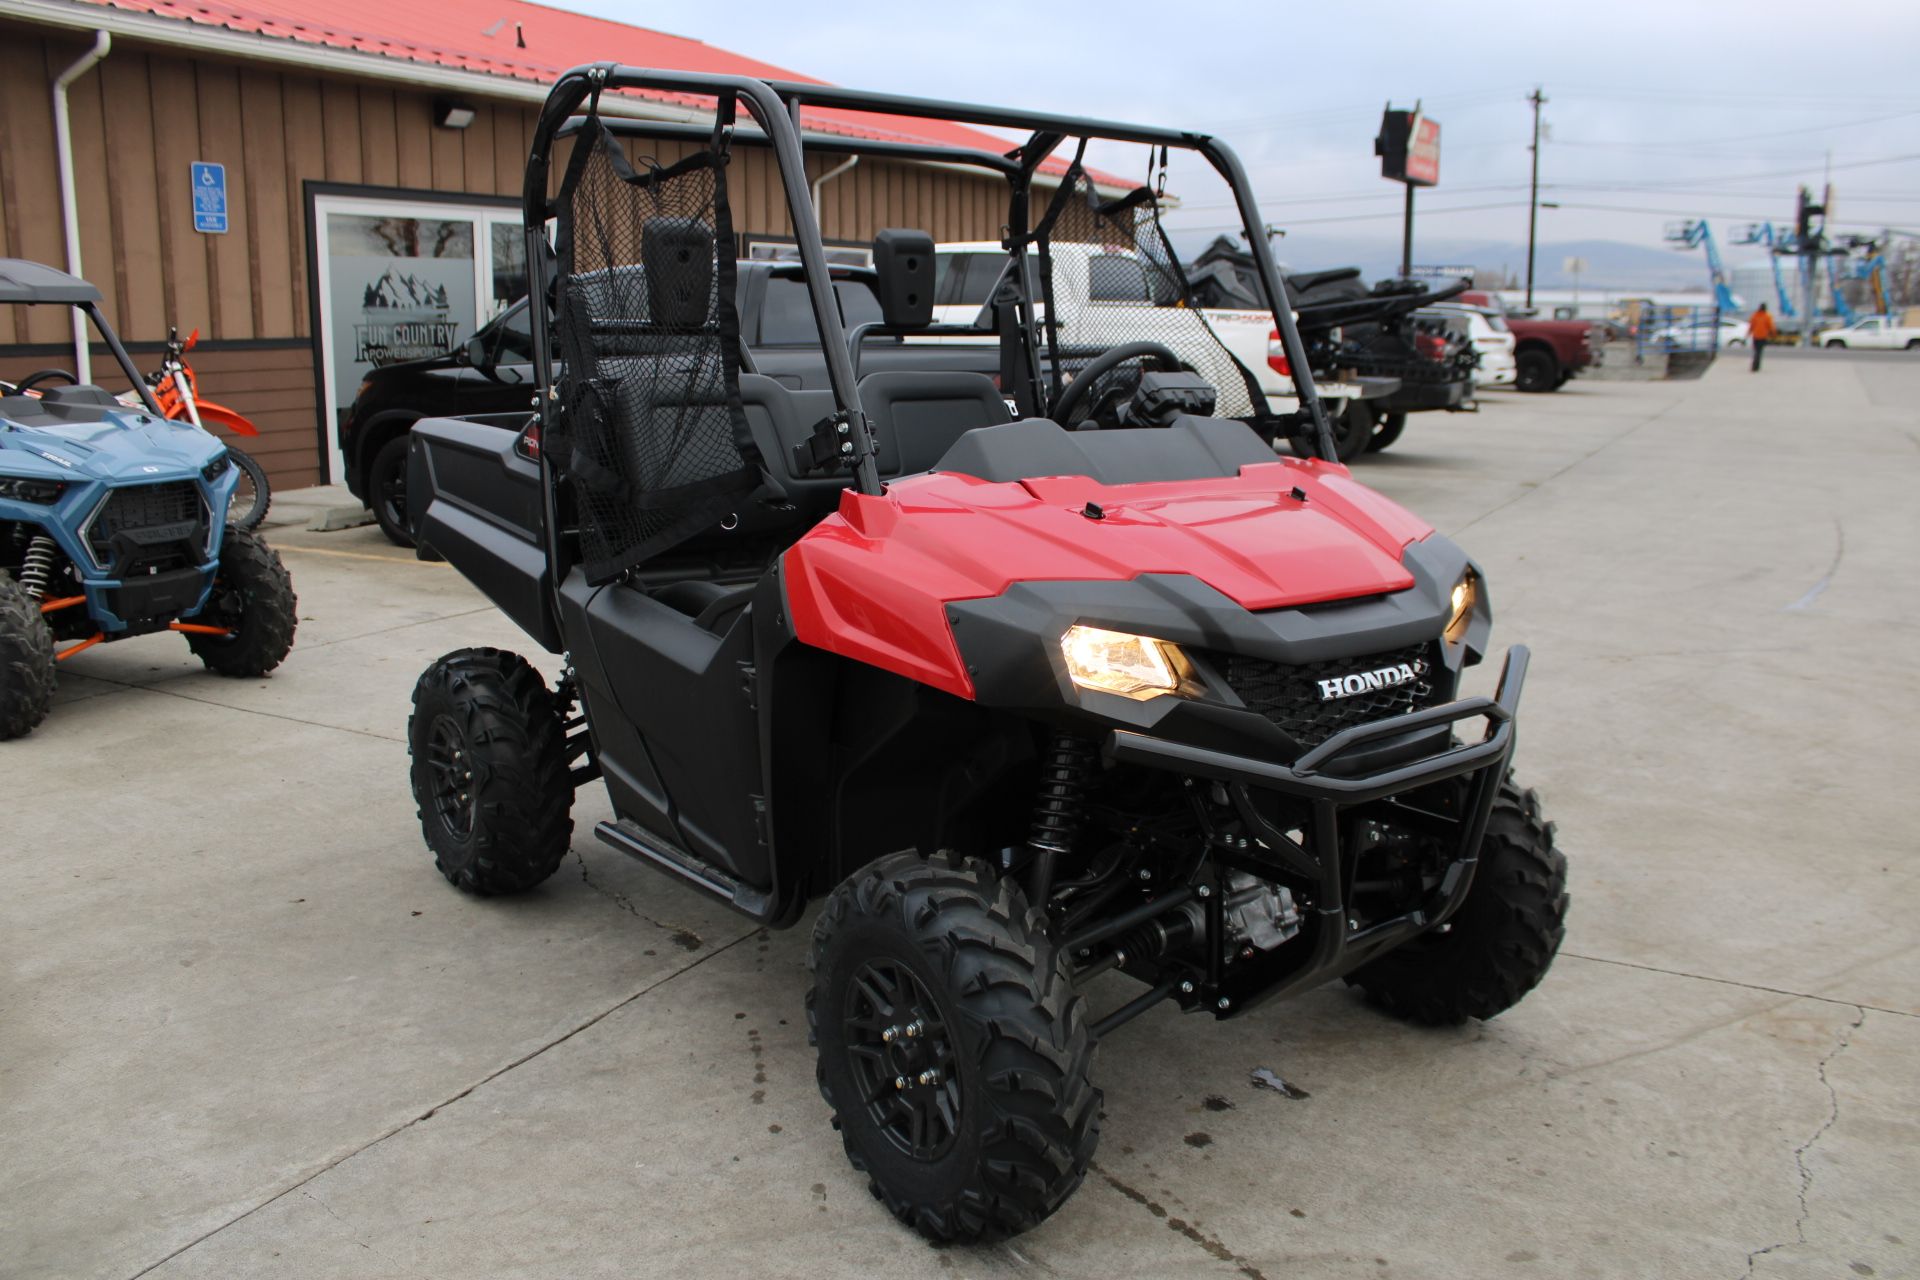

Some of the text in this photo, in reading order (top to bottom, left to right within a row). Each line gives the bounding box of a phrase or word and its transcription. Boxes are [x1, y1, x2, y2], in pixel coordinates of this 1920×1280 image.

[353, 322, 459, 362] FUN COUNTRY
[368, 346, 446, 360] POWERSPORTS
[1317, 662, 1416, 701] HONDA
